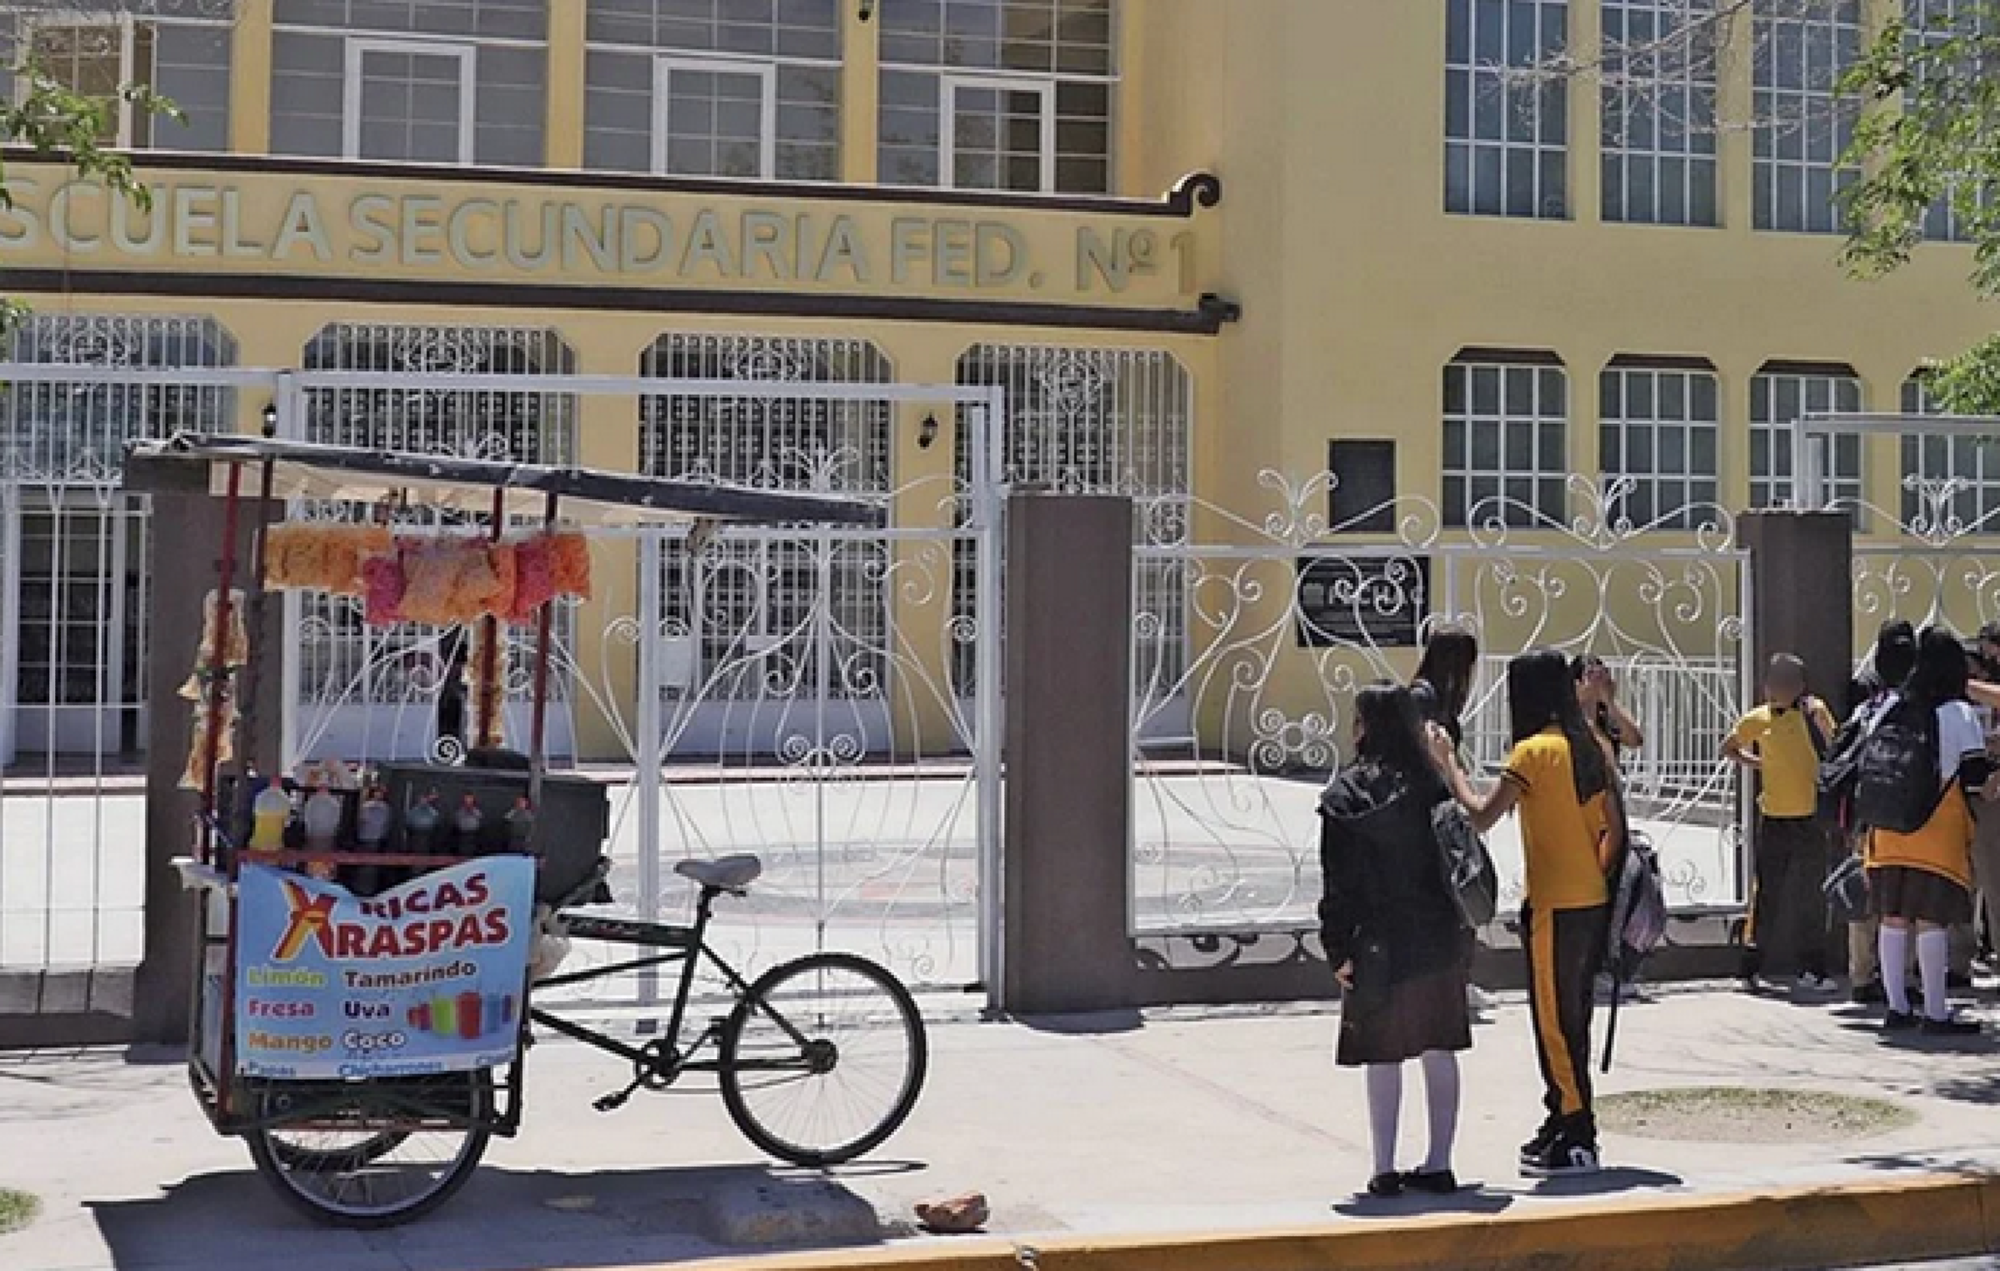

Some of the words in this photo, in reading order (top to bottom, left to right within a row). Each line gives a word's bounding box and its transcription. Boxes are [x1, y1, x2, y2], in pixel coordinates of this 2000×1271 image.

[348, 192, 870, 285] SECUNDARIA
[891, 217, 1045, 290] FED.
[343, 960, 478, 988] Tamarindo
[247, 999, 315, 1018] Fresa
[343, 1000, 390, 1019] Uva
[247, 1031, 332, 1054] Mango
[343, 1029, 406, 1049] Coco
